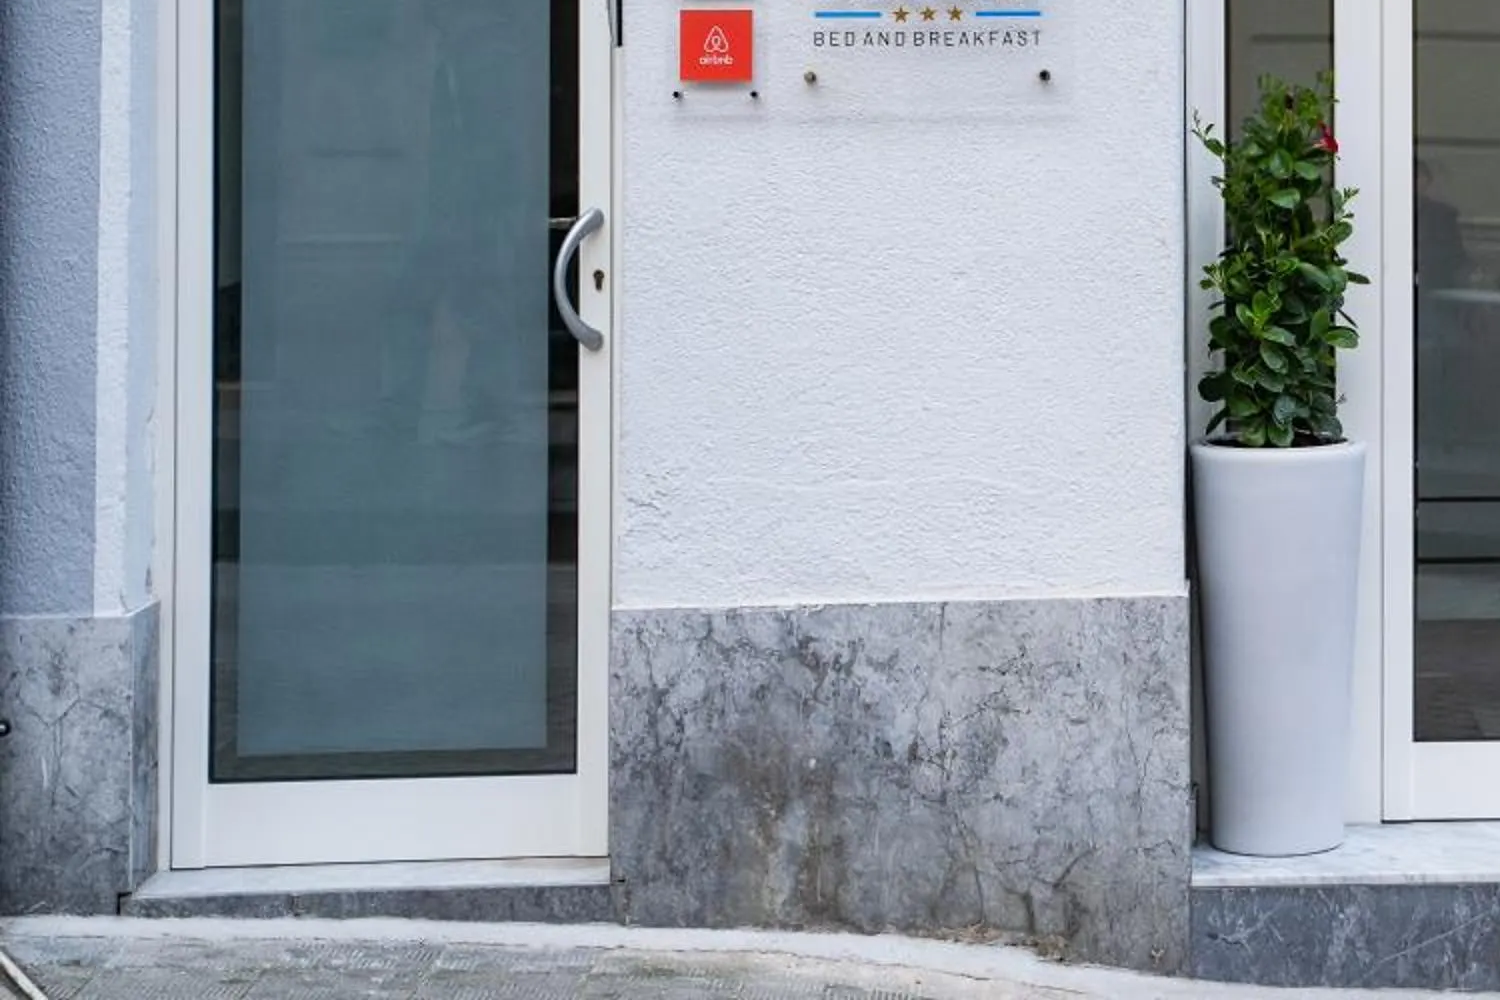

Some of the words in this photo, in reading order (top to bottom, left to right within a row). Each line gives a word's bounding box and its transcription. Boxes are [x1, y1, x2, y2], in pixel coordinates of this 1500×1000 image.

[813, 31, 855, 47] BED
[863, 31, 905, 47] AND
[913, 31, 1041, 47] BREAKFAST
[699, 54, 734, 65] airbnb
